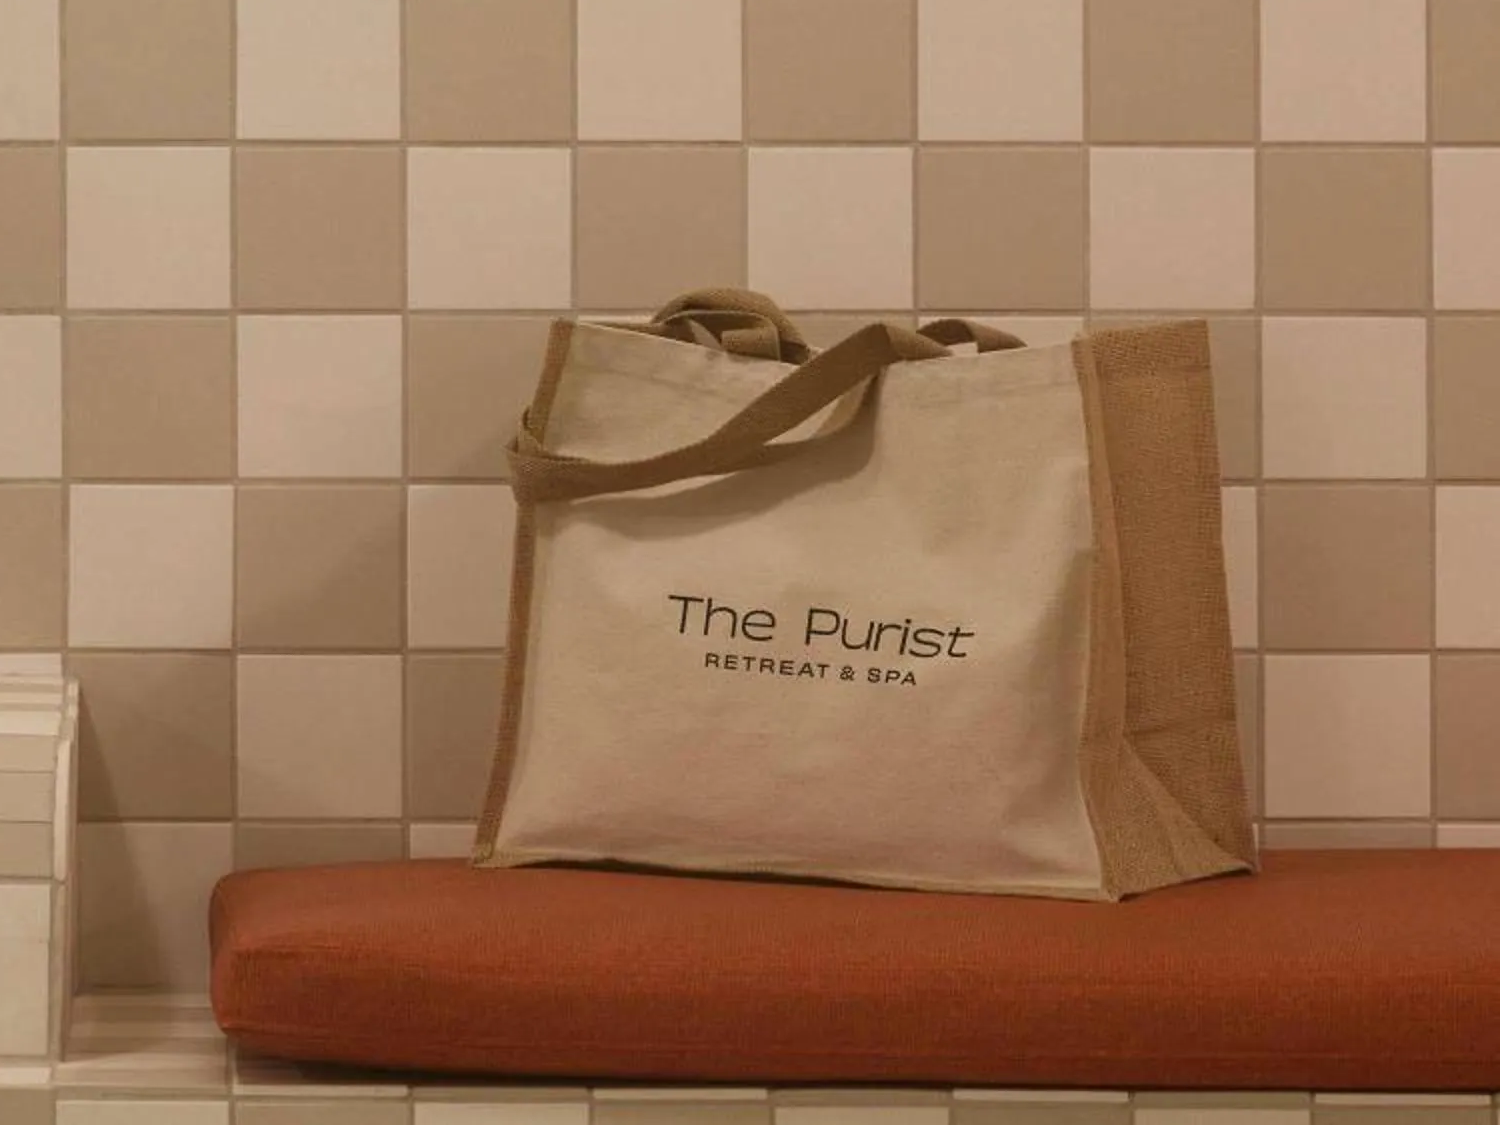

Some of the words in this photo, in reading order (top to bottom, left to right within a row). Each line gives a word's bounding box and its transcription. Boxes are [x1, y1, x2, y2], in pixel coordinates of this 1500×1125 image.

[667, 594, 777, 643] The
[804, 607, 976, 658] Purist
[704, 652, 832, 680] RETREAT
[839, 665, 856, 682] &
[867, 667, 918, 687] SPA
